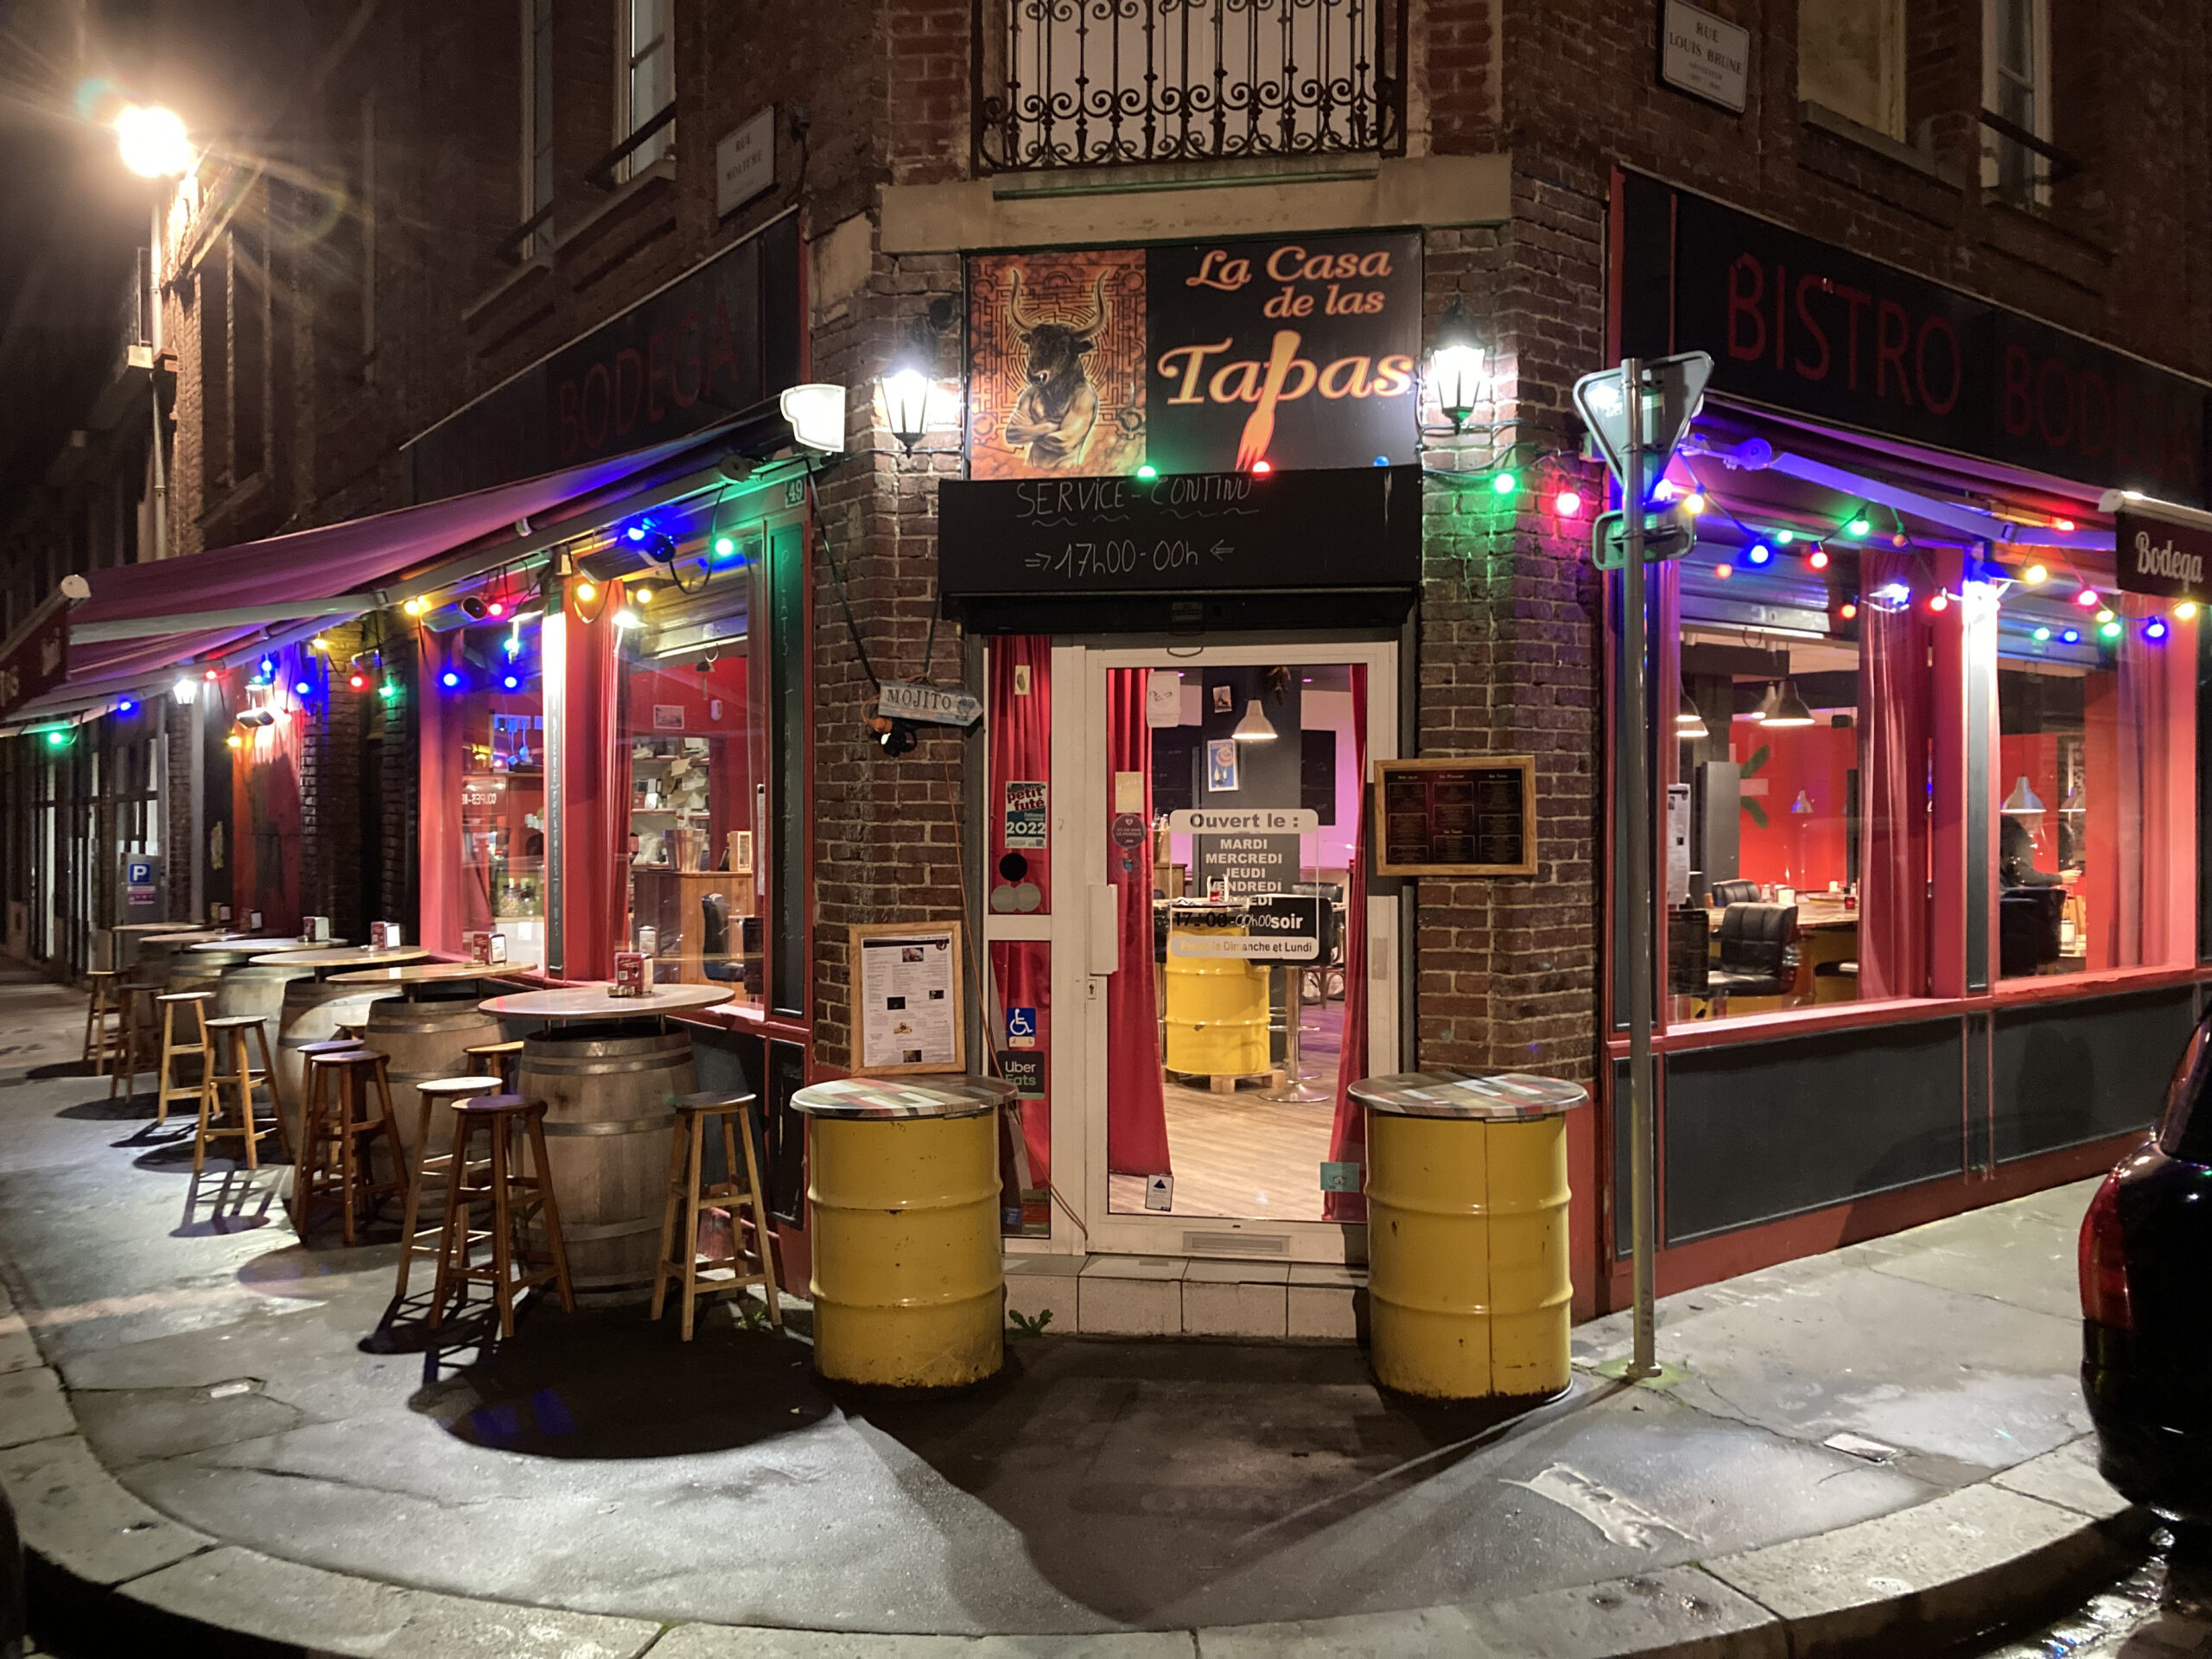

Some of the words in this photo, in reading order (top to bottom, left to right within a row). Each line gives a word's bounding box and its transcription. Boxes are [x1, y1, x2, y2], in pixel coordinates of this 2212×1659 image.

[1695, 22, 1719, 44] RUE
[1669, 31, 1702, 57] LOUIS
[1707, 48, 1743, 76] BRUNE
[1185, 249, 1251, 292] La
[1266, 245, 1393, 283] Casa
[1263, 285, 1319, 319] de
[1325, 283, 1386, 315] las
[1728, 251, 1961, 416] BISTRO
[558, 296, 741, 460] BODEGA
[1156, 329, 1414, 471] Tapas
[788, 480, 803, 501] 49
[2135, 531, 2203, 593] Bodega
[887, 689, 951, 709] MOJITO
[1007, 786, 1043, 804] petit
[1014, 798, 1045, 811] futé
[1007, 821, 1046, 835] 2022
[1190, 813, 1260, 828] Ouvert
[1267, 813, 1286, 828] le
[1220, 839, 1268, 850] MARDI
[1205, 853, 1282, 864] MERCREDI
[132, 866, 148, 881] P
[1223, 868, 1266, 879] JEUDI
[1209, 881, 1282, 893] VENDREDI
[1273, 941, 1281, 953] et
[1285, 940, 1313, 952] Lundi
[1005, 1060, 1036, 1073] Uber
[1005, 1074, 1037, 1087] Eats
